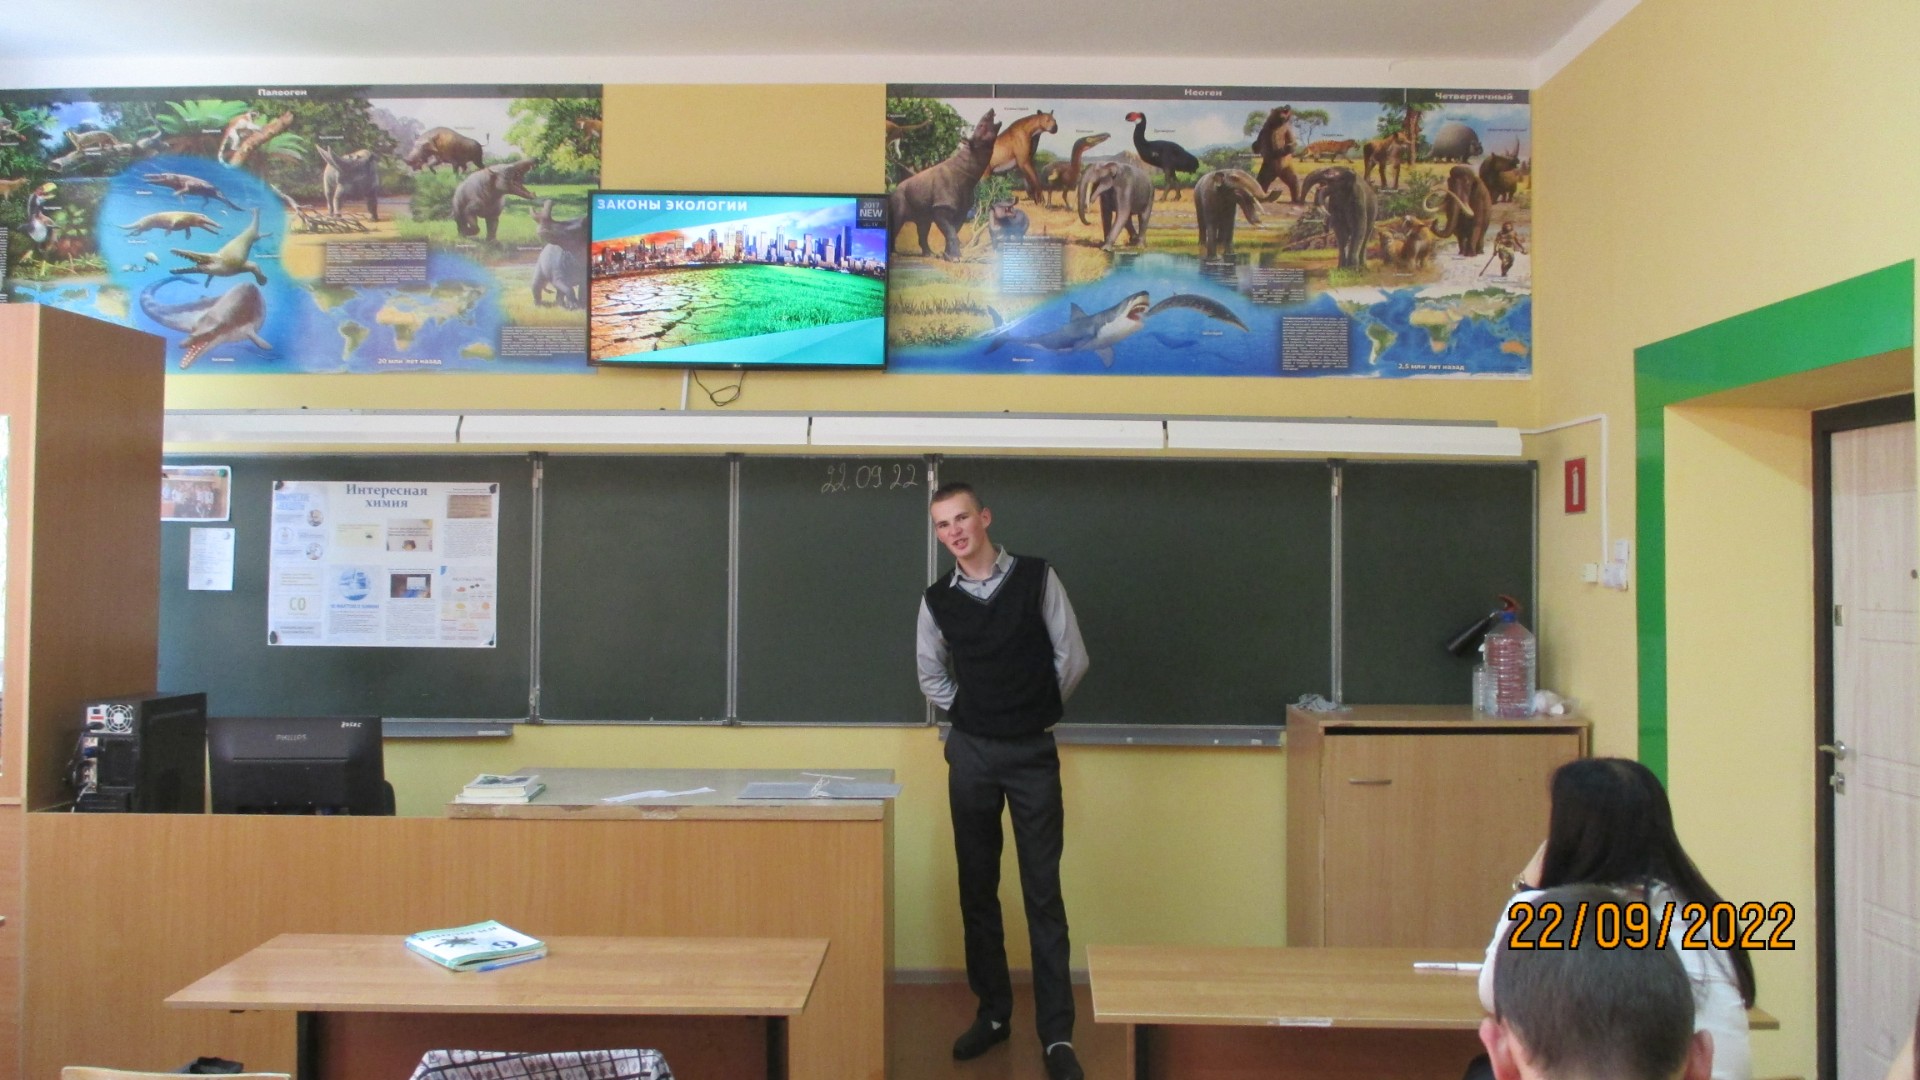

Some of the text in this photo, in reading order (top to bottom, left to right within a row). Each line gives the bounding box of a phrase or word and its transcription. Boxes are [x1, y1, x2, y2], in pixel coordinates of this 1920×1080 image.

[257, 88, 308, 96] Палеоген
[1184, 88, 1223, 96] Неоген
[1434, 91, 1514, 101] Четвертичный
[597, 198, 748, 212] ЗАКОНЫ ЭКОЛОГИИ
[863, 201, 880, 209] 2017
[859, 208, 883, 218] NEW
[346, 483, 428, 499] Интересная
[365, 499, 408, 509] химия
